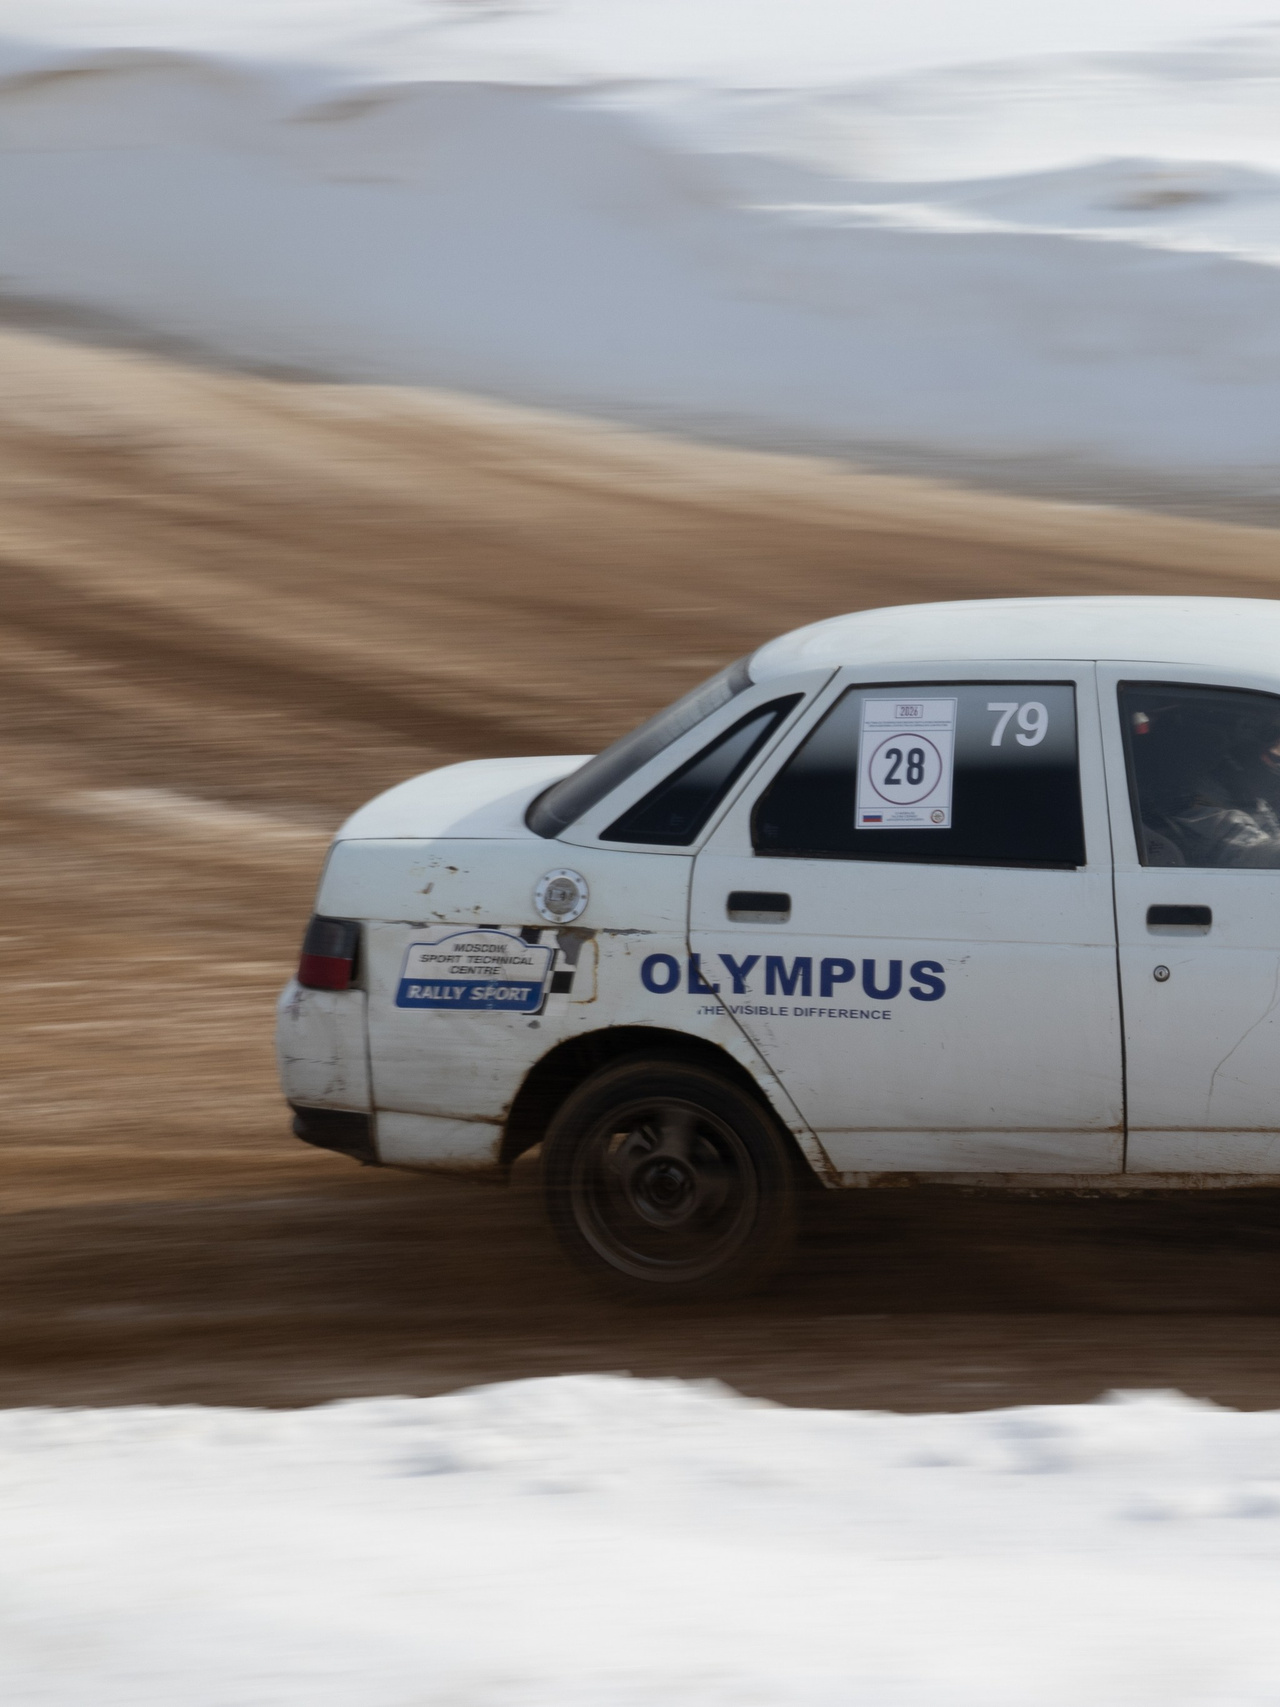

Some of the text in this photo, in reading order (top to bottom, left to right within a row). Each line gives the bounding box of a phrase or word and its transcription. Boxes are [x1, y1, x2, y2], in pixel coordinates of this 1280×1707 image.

[987, 701, 1049, 747] 79
[884, 747, 925, 786] 28
[453, 943, 508, 953] MOSCOW
[420, 954, 534, 965] SPORT TECHNICAL
[450, 965, 501, 975] CENTRE
[641, 953, 947, 1002] OLYMPUS
[406, 985, 532, 1001] RALLY SPORT
[729, 1004, 789, 1017] VISIBLE
[793, 1007, 892, 1020] DIFFERENCE
